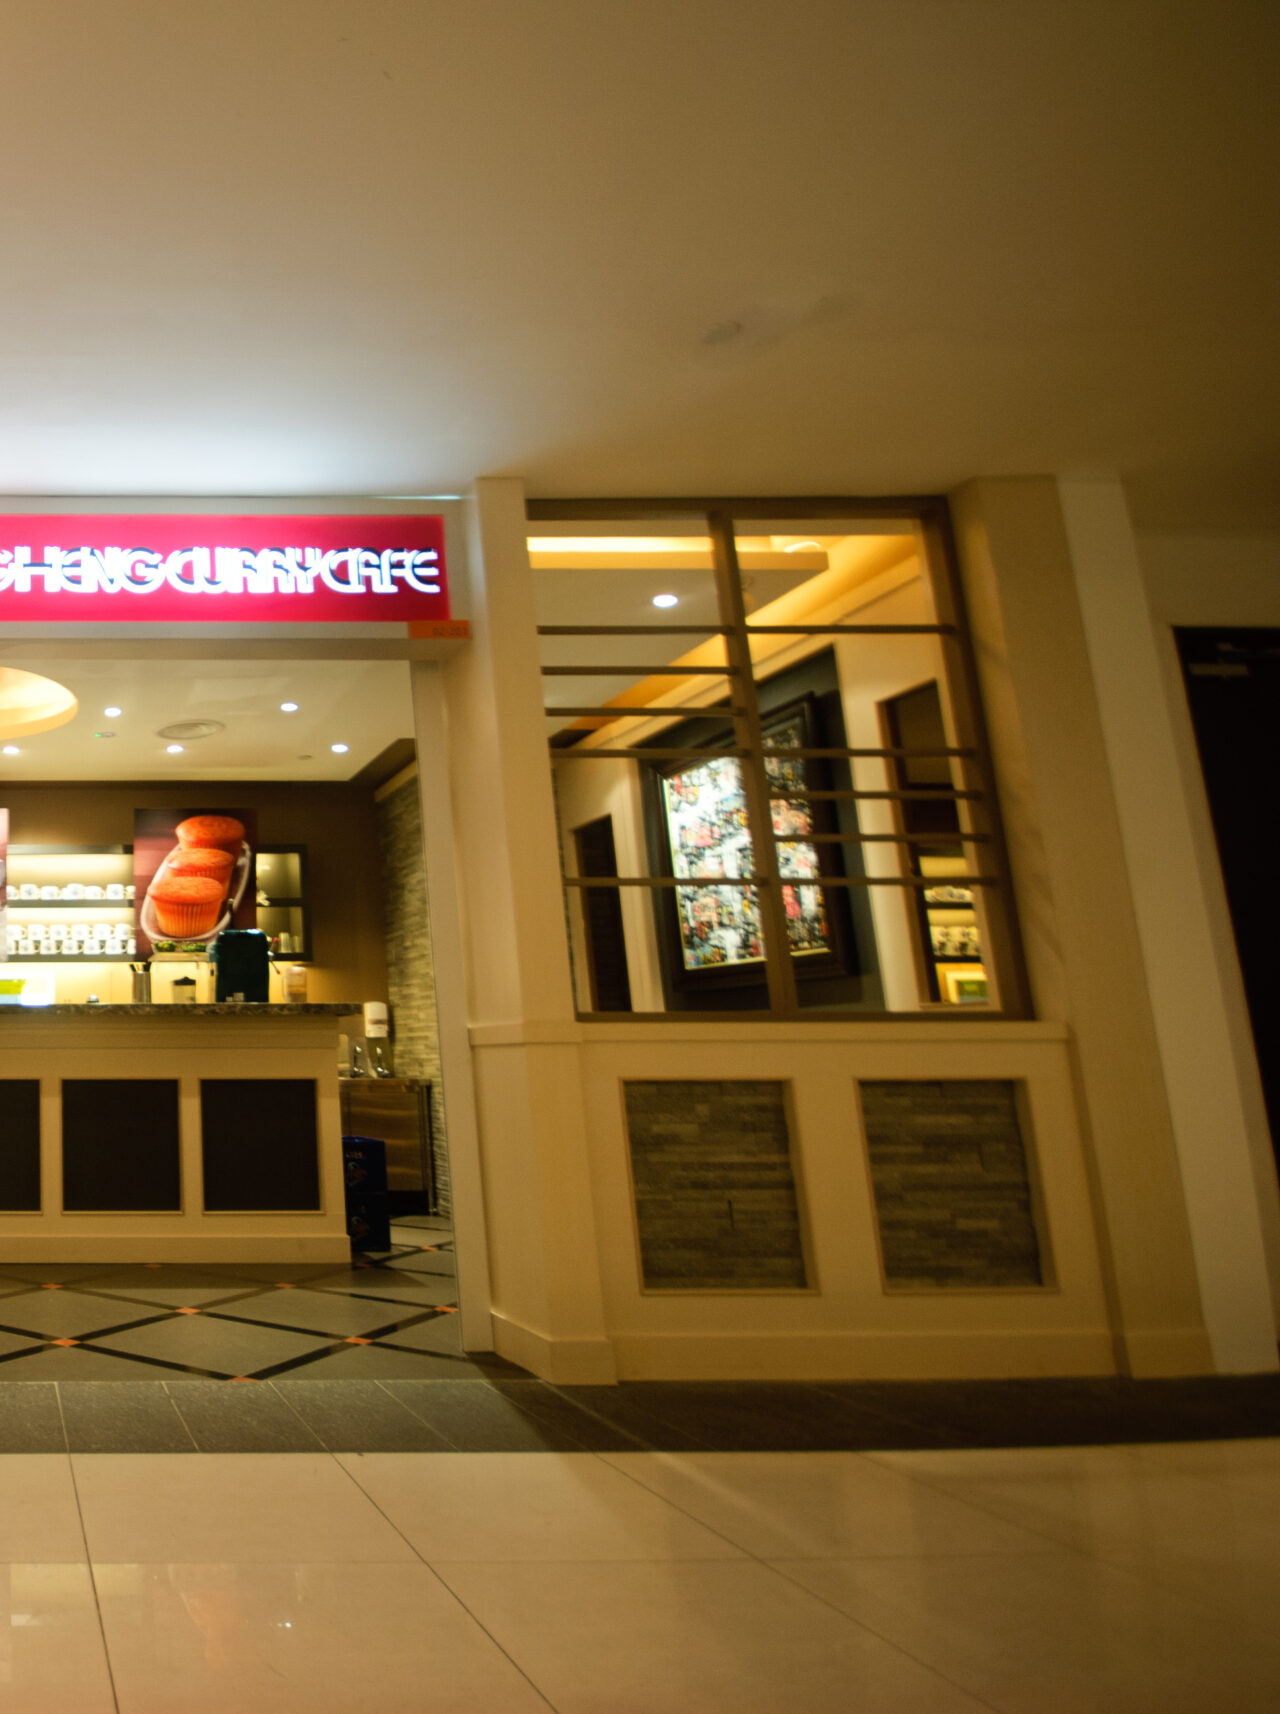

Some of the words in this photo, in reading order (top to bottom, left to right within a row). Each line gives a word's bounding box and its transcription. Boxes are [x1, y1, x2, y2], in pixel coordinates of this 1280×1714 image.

[14, 546, 167, 593] HENG
[166, 546, 321, 593] CURRY
[320, 547, 440, 593] CAFE
